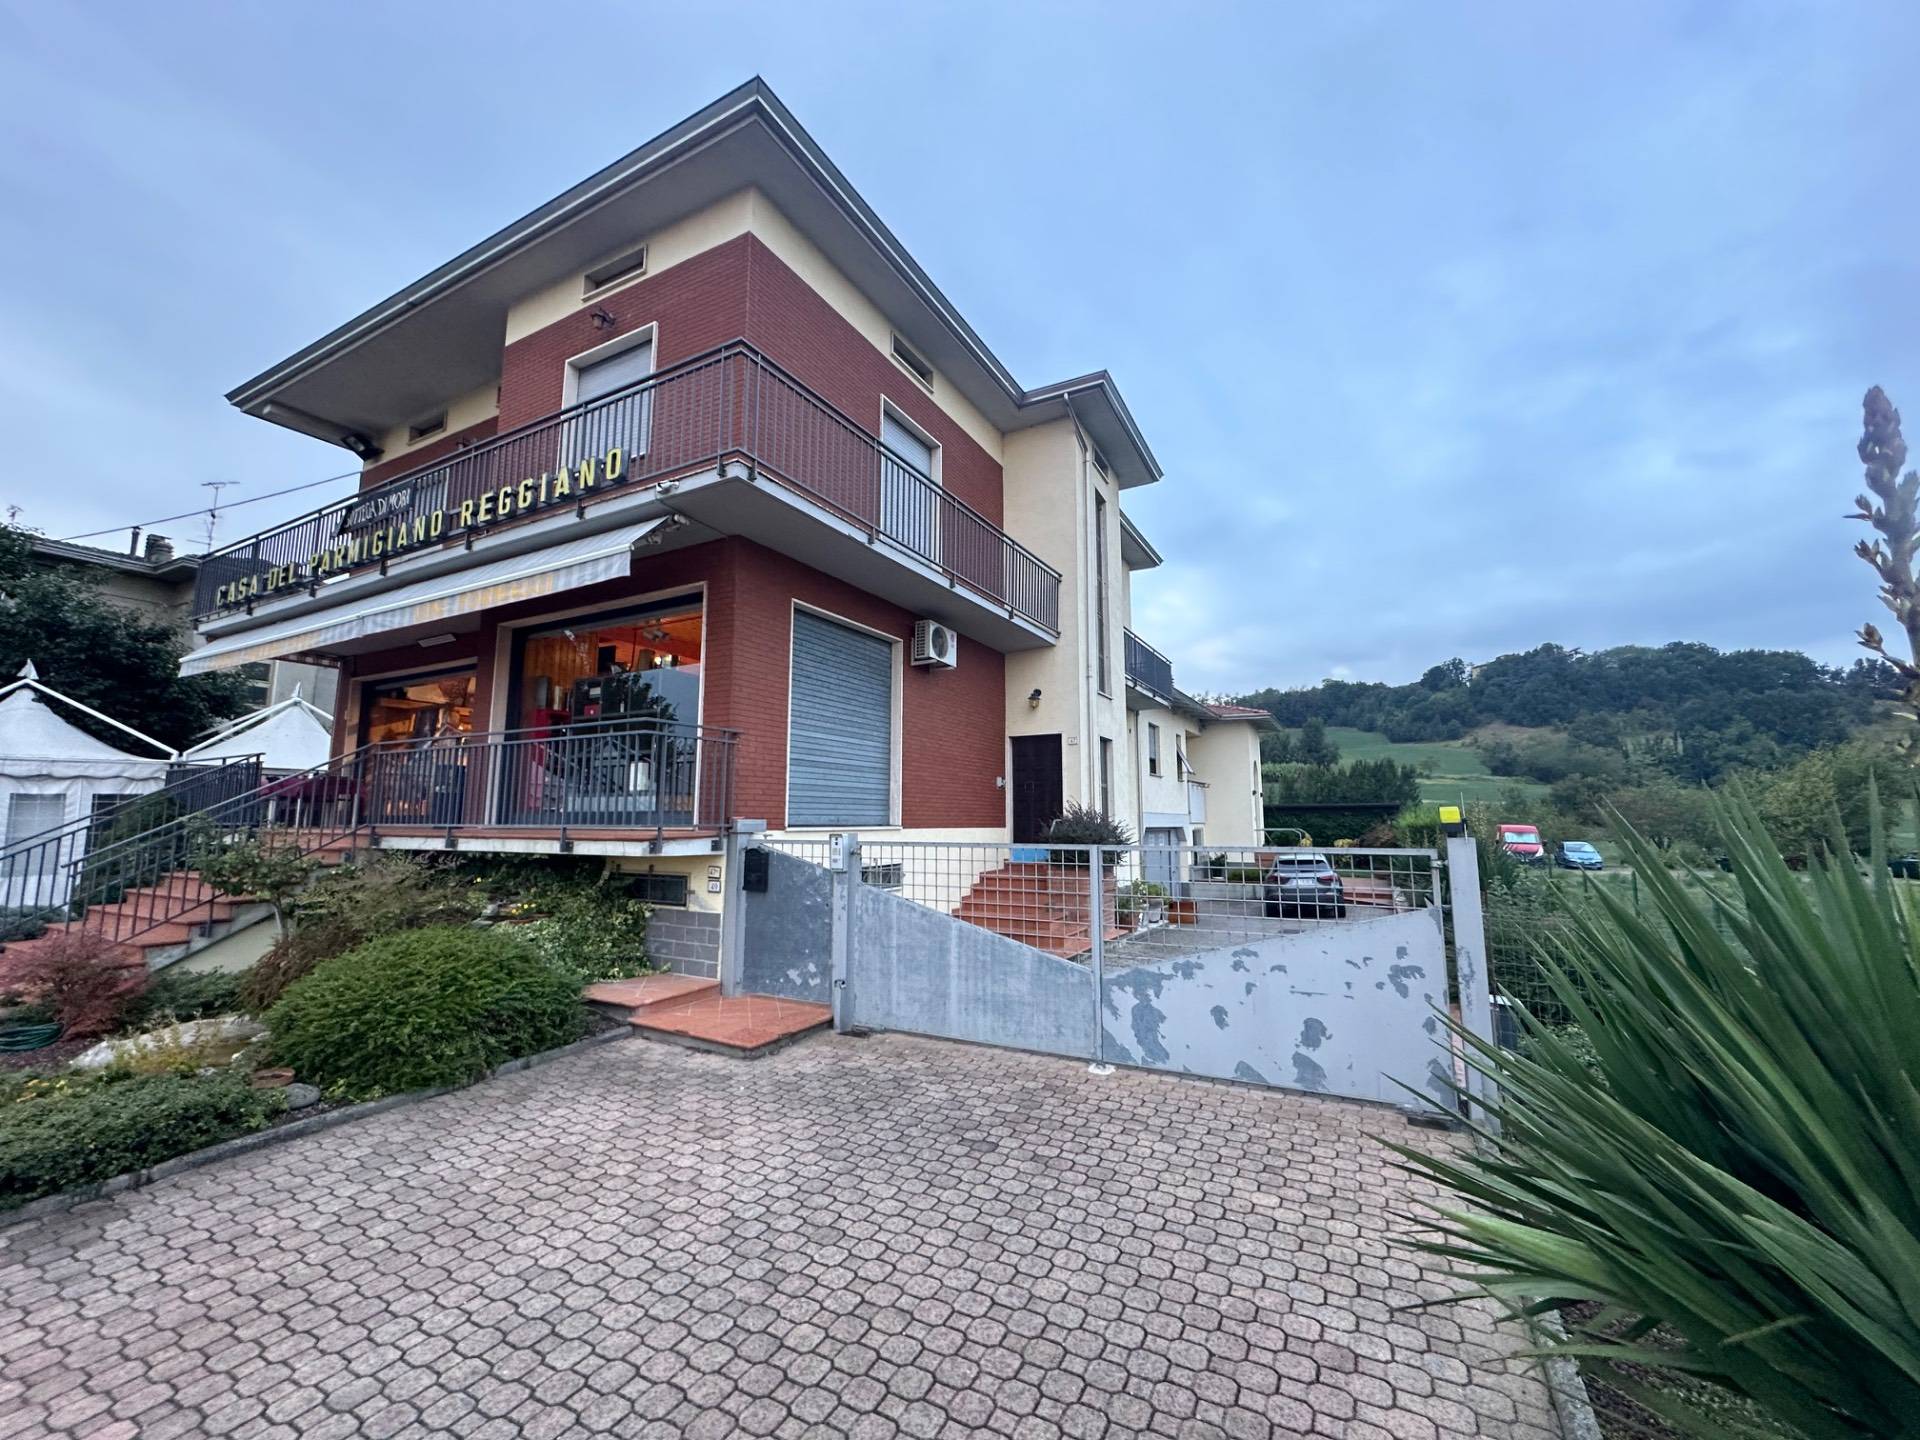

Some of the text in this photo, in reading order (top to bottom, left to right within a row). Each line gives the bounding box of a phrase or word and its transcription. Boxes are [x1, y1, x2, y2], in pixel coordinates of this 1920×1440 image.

[217, 448, 622, 606] CASA DEL PARMIGIANO REGGIANO
